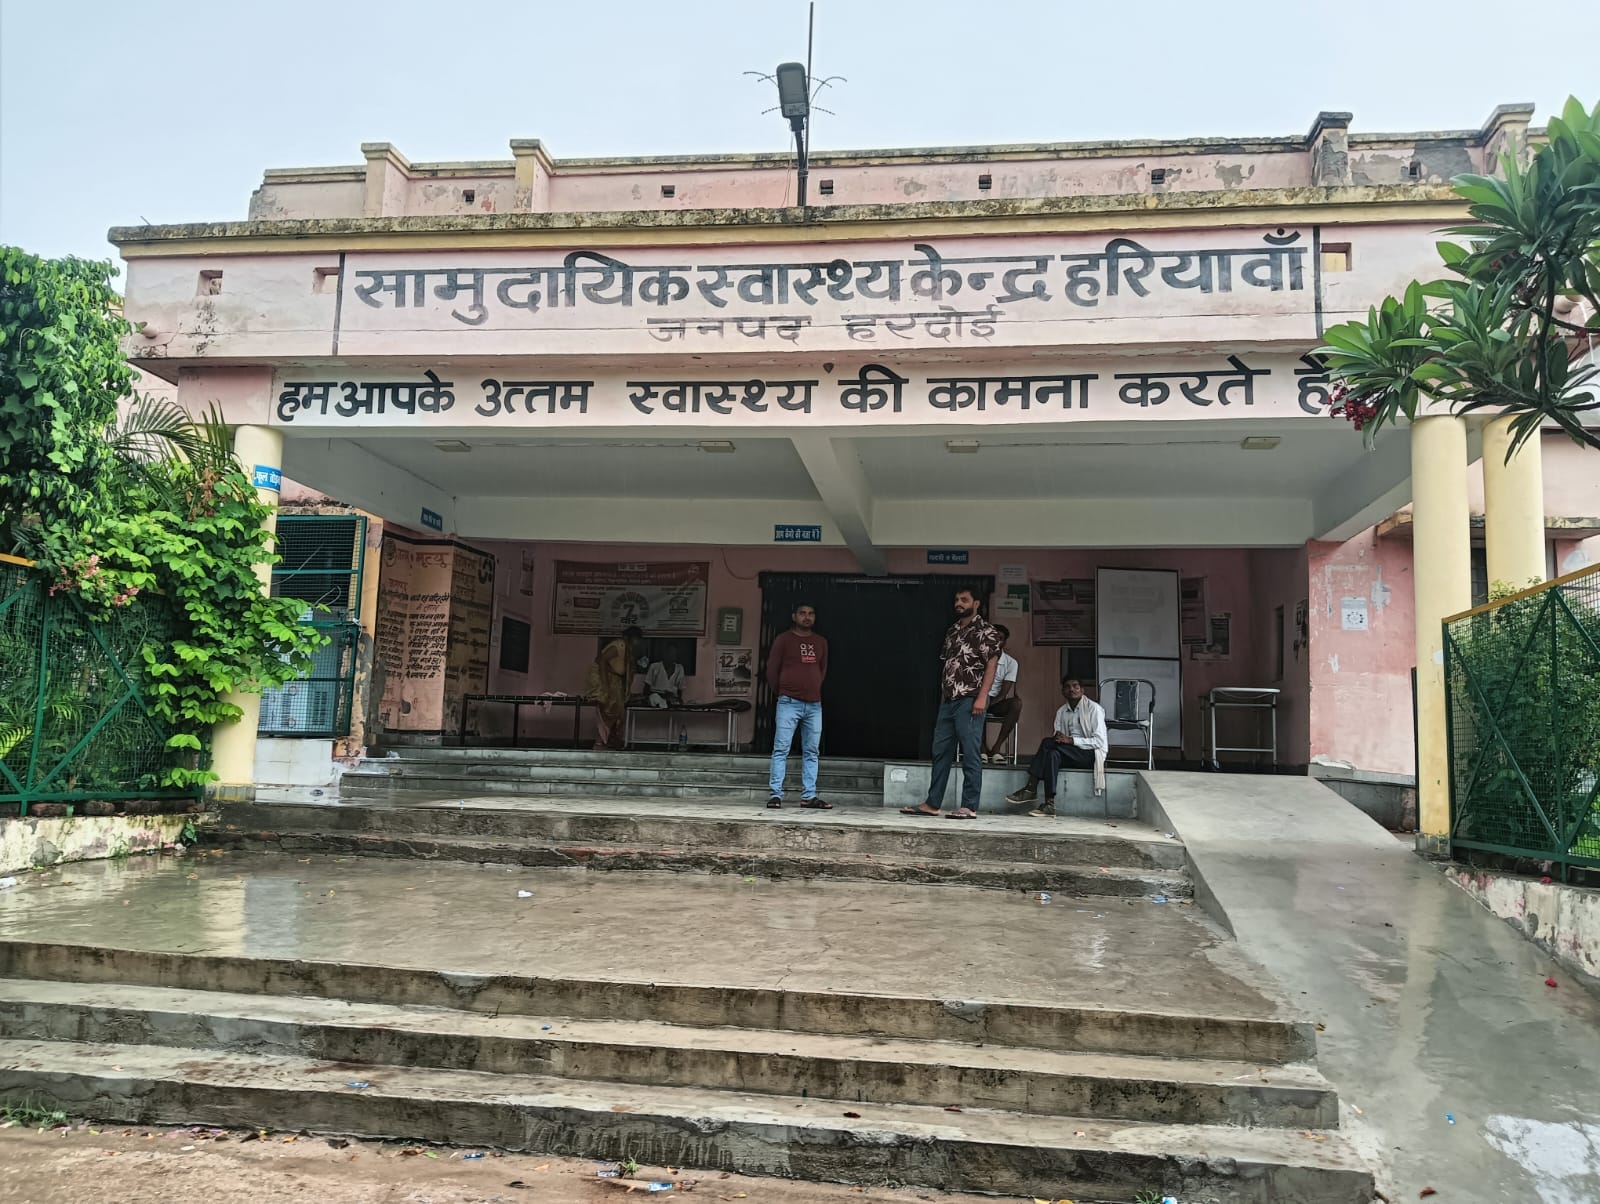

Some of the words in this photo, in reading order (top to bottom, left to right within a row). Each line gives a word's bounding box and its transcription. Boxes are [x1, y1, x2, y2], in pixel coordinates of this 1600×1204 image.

[354, 251, 691, 325] सामुदायिक
[908, 243, 1055, 303] केन्द्र
[647, 315, 812, 345] जनपद
[840, 303, 1006, 343] हरदोई
[474, 378, 594, 417] उत्तम
[627, 378, 818, 414] स्वास्थ्य
[838, 364, 909, 412] की
[927, 373, 1099, 411] कामना
[1114, 355, 1271, 408] करते
